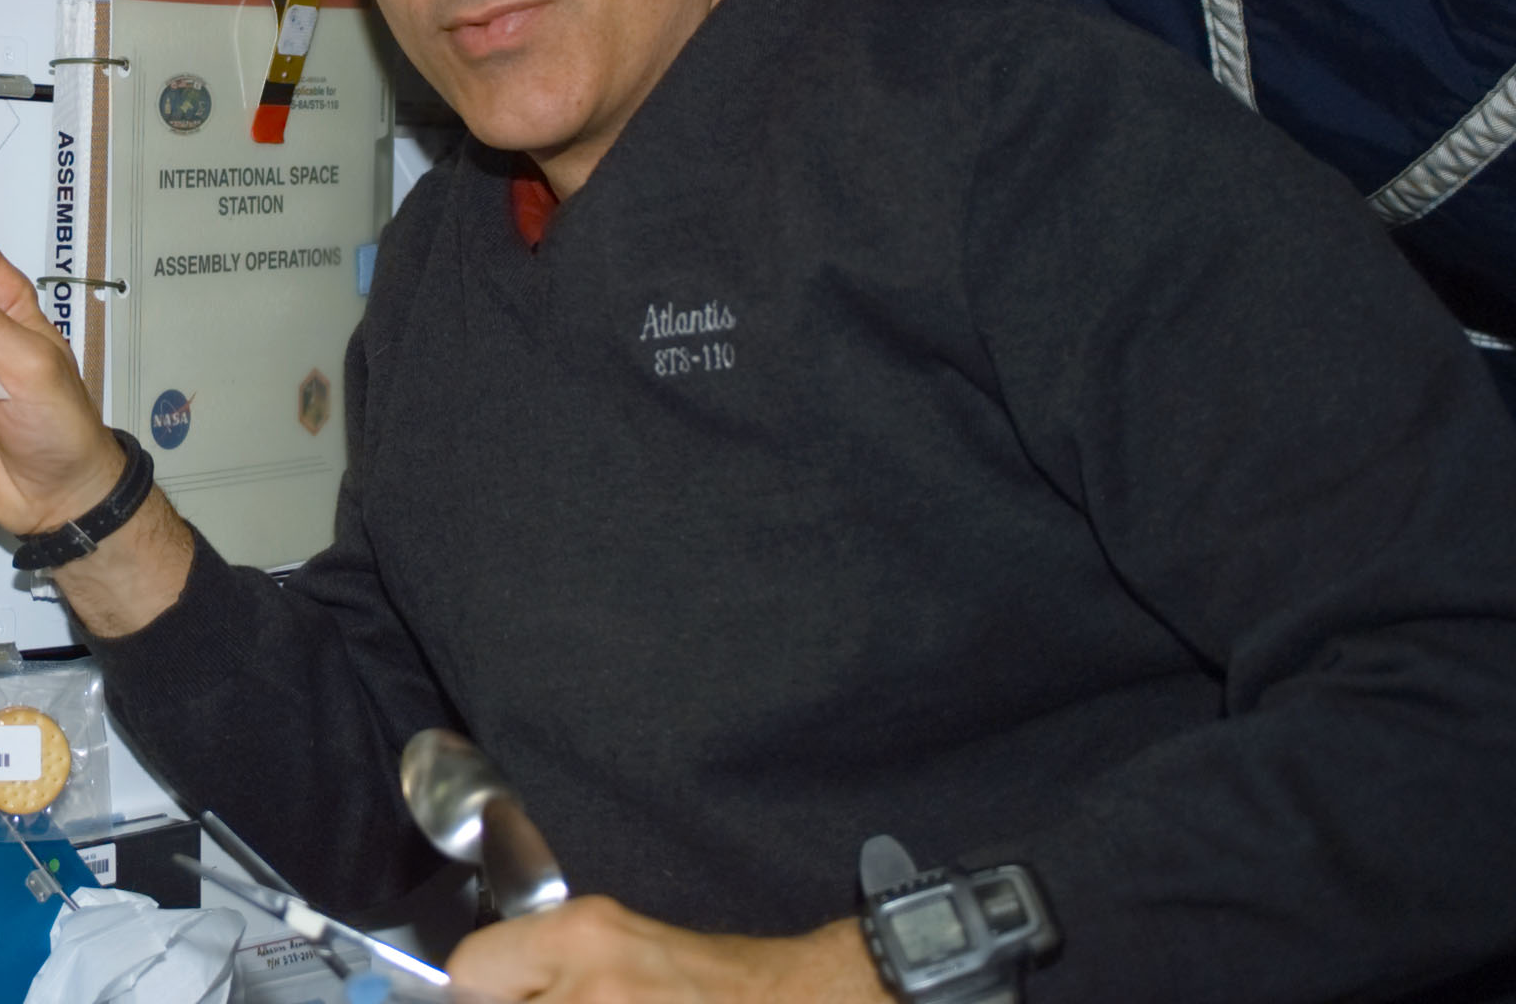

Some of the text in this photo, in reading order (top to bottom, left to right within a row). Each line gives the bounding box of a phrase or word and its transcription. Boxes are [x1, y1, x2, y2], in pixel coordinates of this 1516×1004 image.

[158, 164, 340, 190] INTERNATIONAL SPACE
[56, 131, 74, 274] ASSEMBLY
[218, 194, 284, 216] STATION
[154, 246, 342, 277] ASSEMBLY OPERATIONS
[52, 280, 72, 343] OPE
[640, 299, 736, 341] Atlantis
[654, 342, 736, 376] STS-110
[153, 412, 188, 428] NASA
